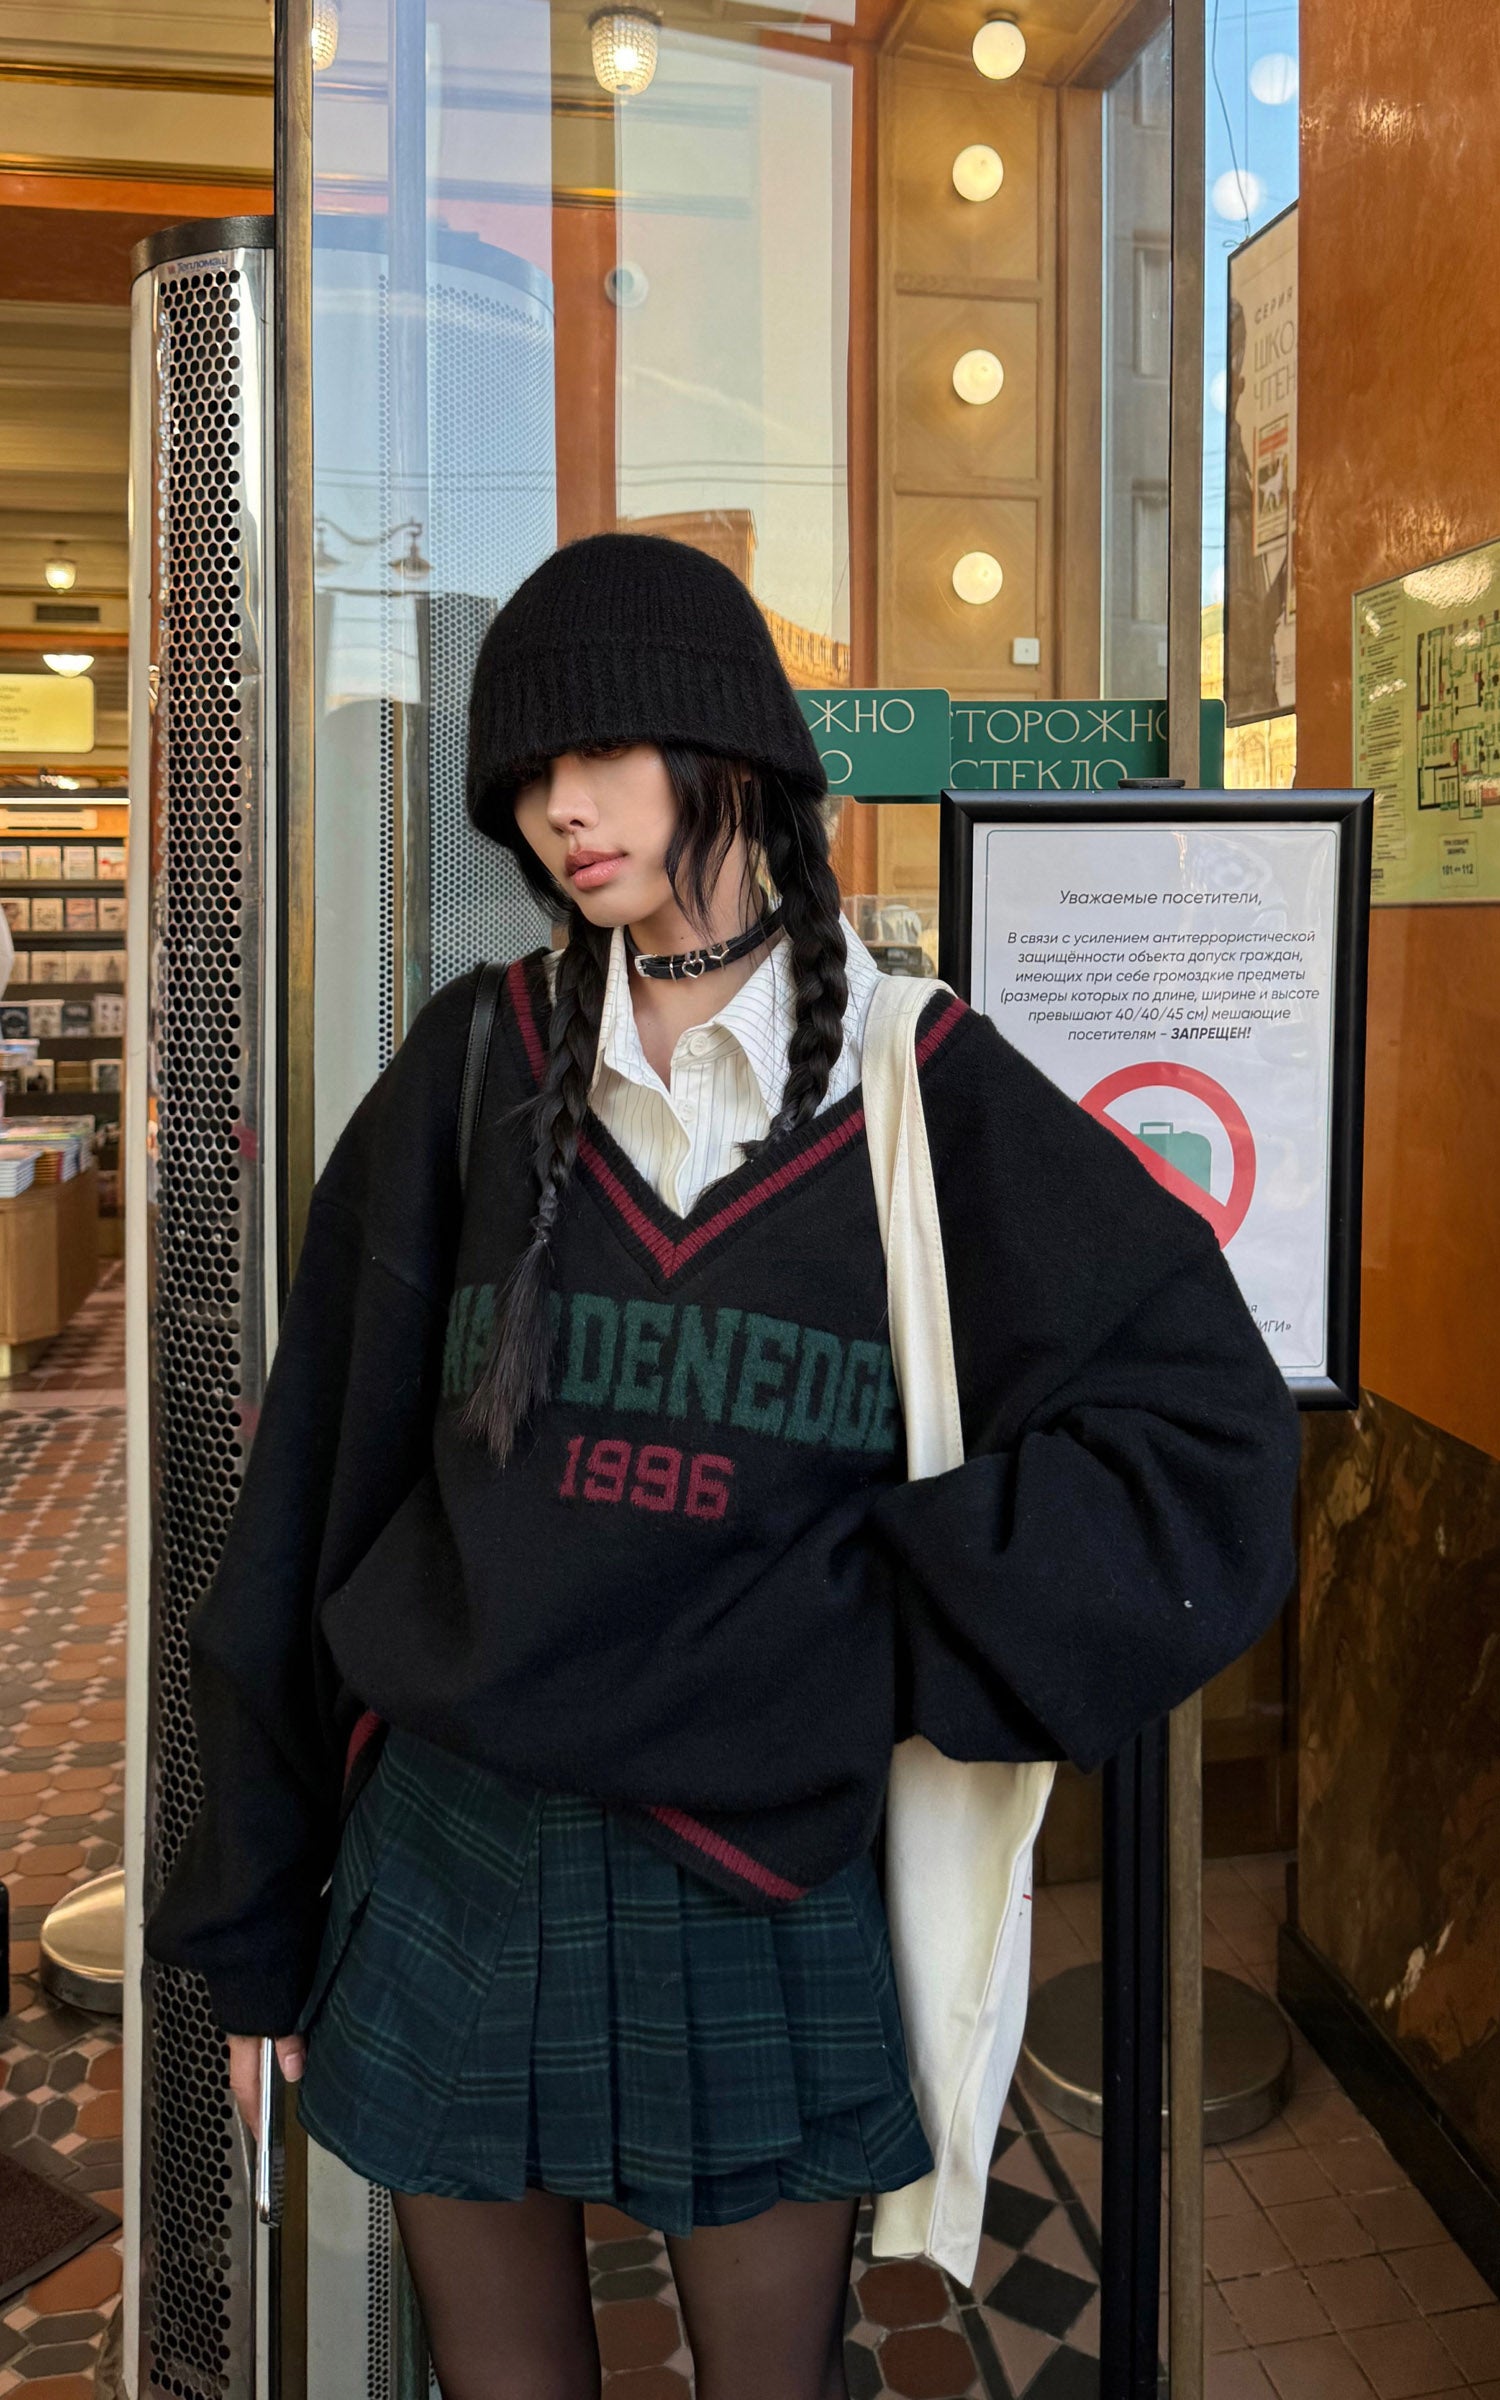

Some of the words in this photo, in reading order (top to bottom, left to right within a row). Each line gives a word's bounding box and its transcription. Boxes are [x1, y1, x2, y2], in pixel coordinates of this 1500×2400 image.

[1254, 285, 1293, 325] СЕРИЯ
[1254, 320, 1296, 372] ШКО
[1253, 361, 1297, 411] ЧТЕН
[1059, 890, 1158, 904] Уважаемые
[1162, 892, 1263, 906] посетители,
[1007, 932, 1017, 944] В
[1020, 934, 1058, 944] связи
[1062, 934, 1071, 944] с
[1073, 934, 1150, 946] усилением
[1152, 931, 1316, 946] антитеррористической
[1018, 951, 1125, 964] защищённости
[1128, 950, 1185, 963] объекта
[1187, 951, 1236, 964] допуск
[1239, 950, 1303, 964] граждан,
[1015, 972, 1083, 984] имеющих
[1086, 972, 1113, 984] при
[1116, 970, 1150, 982] себе
[1153, 971, 1234, 984] громоздкие
[1237, 970, 1306, 983] предметы
[1000, 988, 1068, 1005] (размеры
[1070, 991, 1130, 1004] которых
[1132, 991, 1150, 1001] по
[1151, 990, 1197, 1003] длине,
[1201, 990, 1256, 1003] ширине
[1259, 990, 1268, 1000] и
[1271, 989, 1320, 1000] высоте
[1028, 1010, 1113, 1024] превышают
[1115, 1007, 1184, 1022] 40/40/45
[1186, 1006, 1209, 1021] см)
[1211, 1008, 1291, 1021] мешающие
[1068, 1030, 1157, 1041] посетителям
[1171, 1027, 1252, 1041] ЗАПРЕЩЕН!
[558, 1434, 736, 1521] 1996
